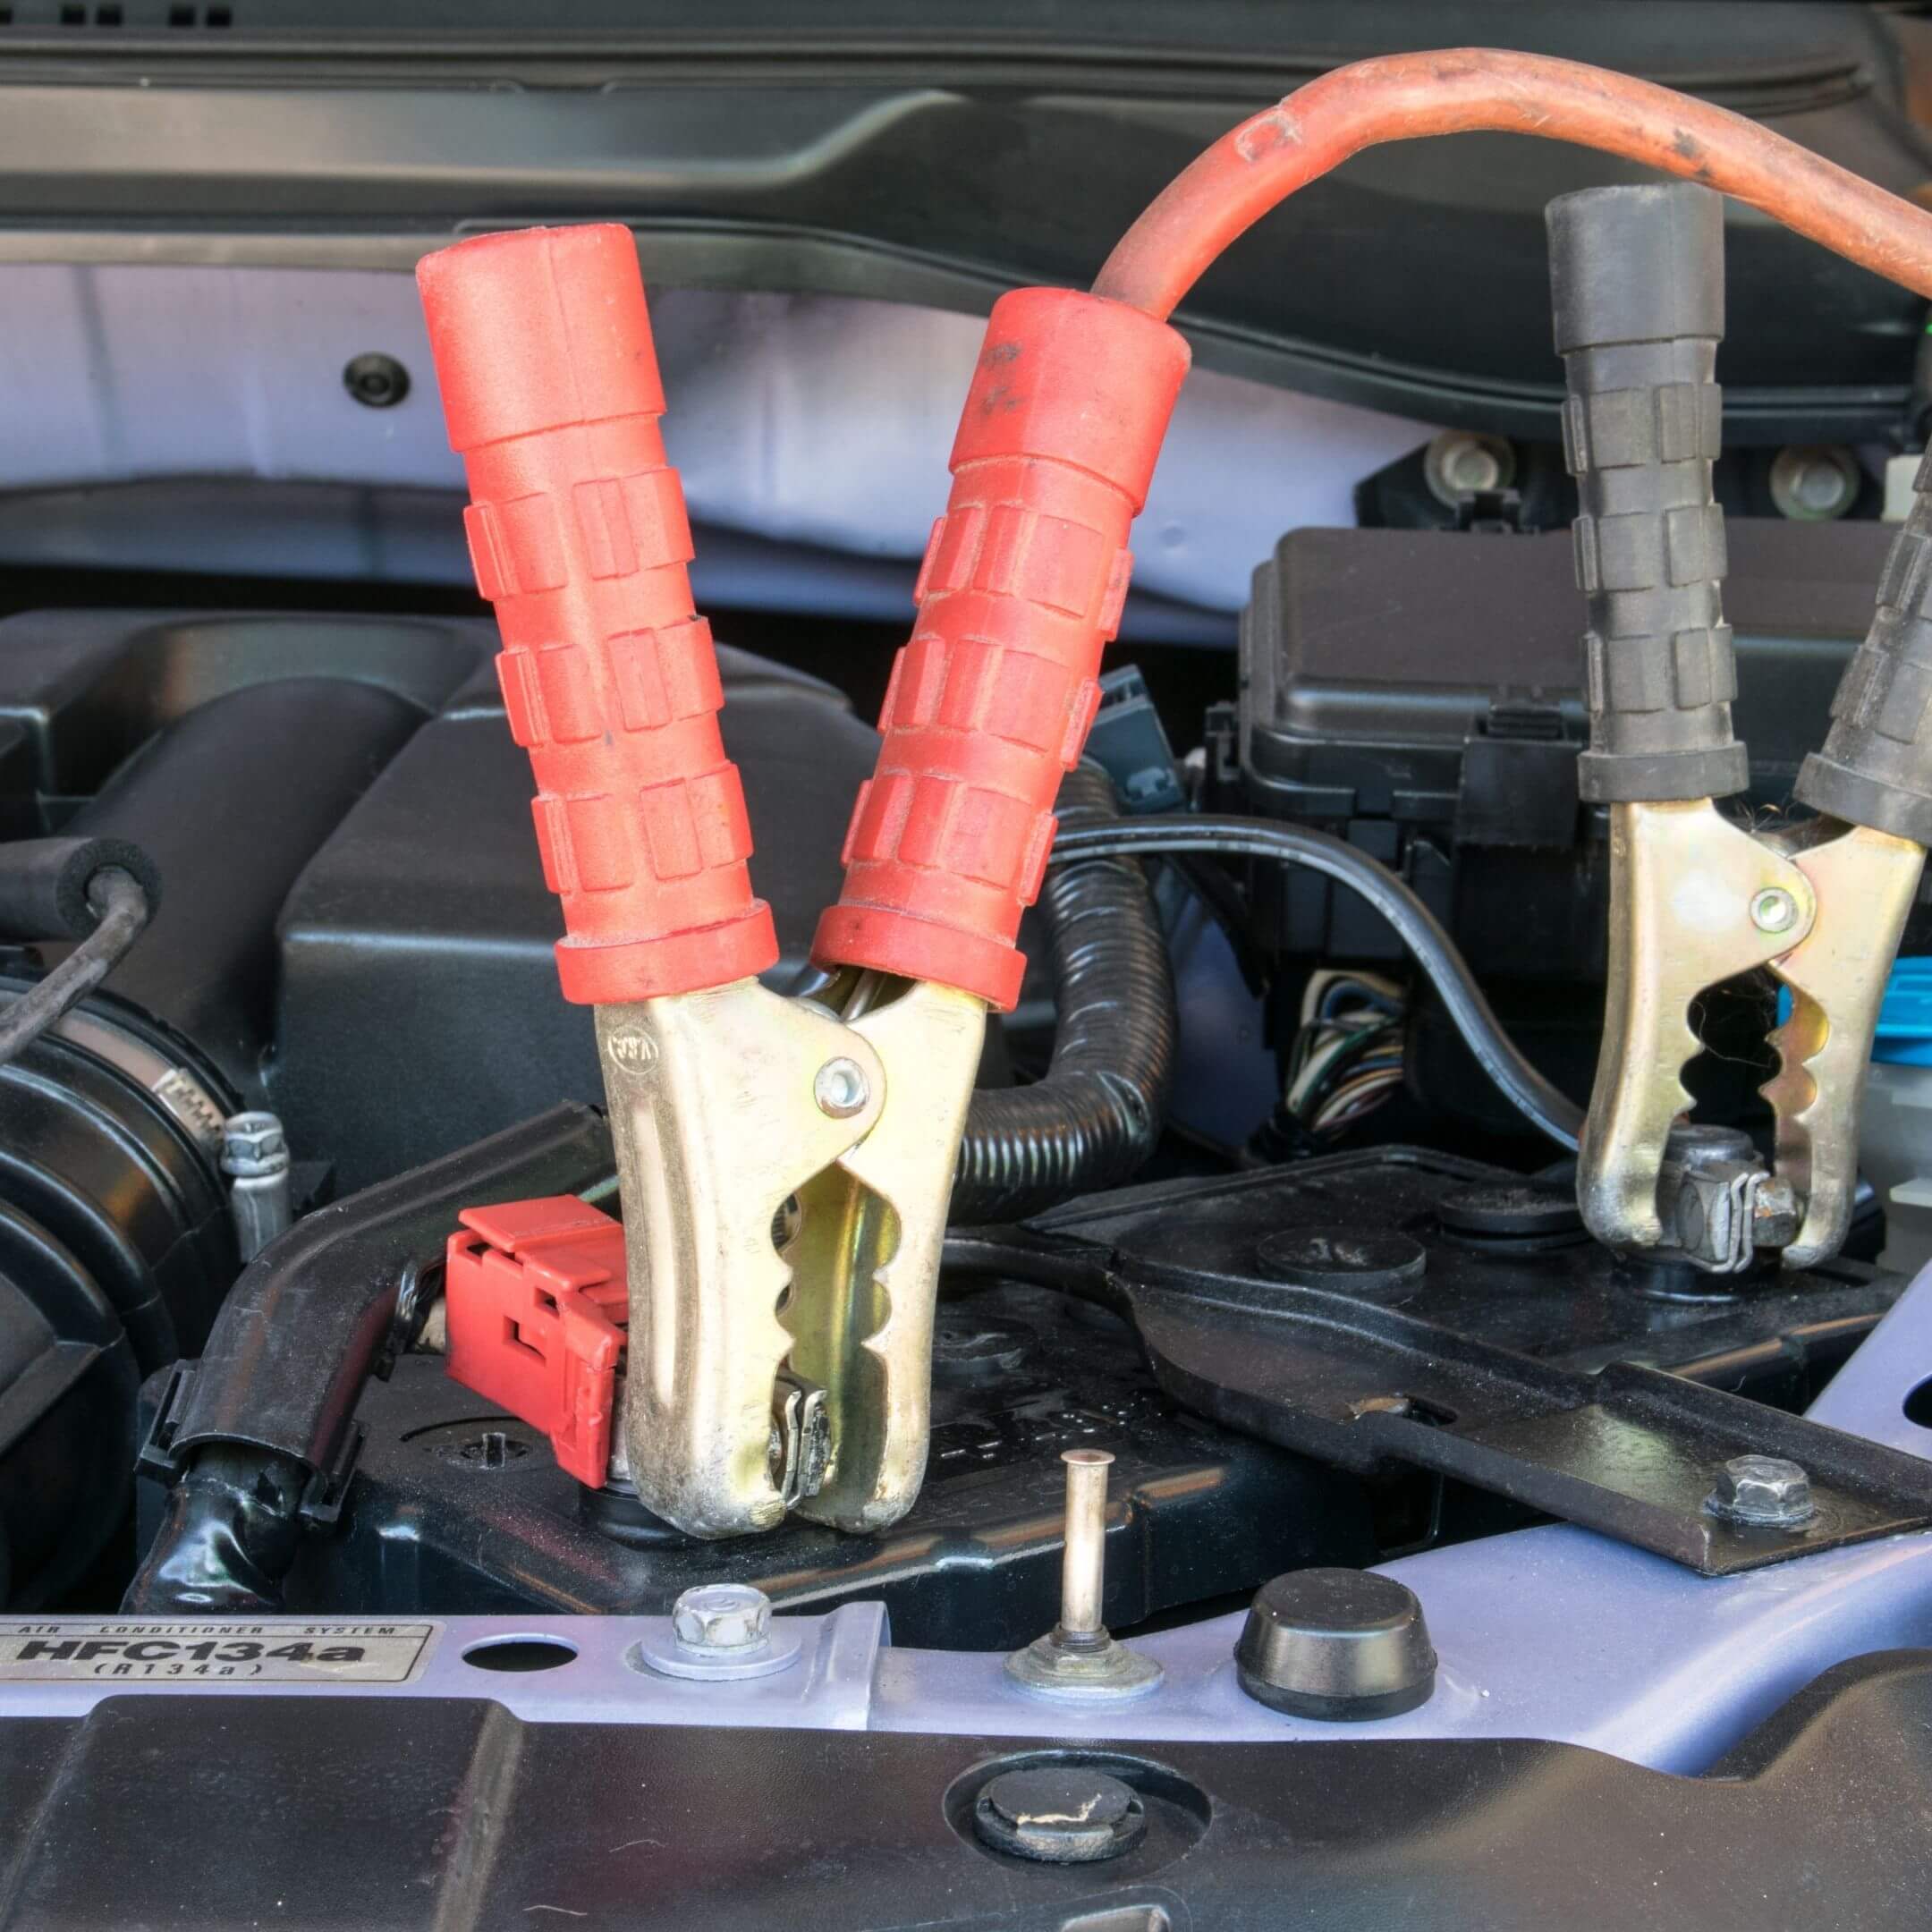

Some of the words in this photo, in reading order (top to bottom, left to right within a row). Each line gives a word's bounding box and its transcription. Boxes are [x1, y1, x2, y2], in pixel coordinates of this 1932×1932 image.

[99, 1626, 263, 1634] CONDITIONER
[304, 1627, 394, 1635] SYSTEM
[16, 1641, 366, 1662] HFC134a
